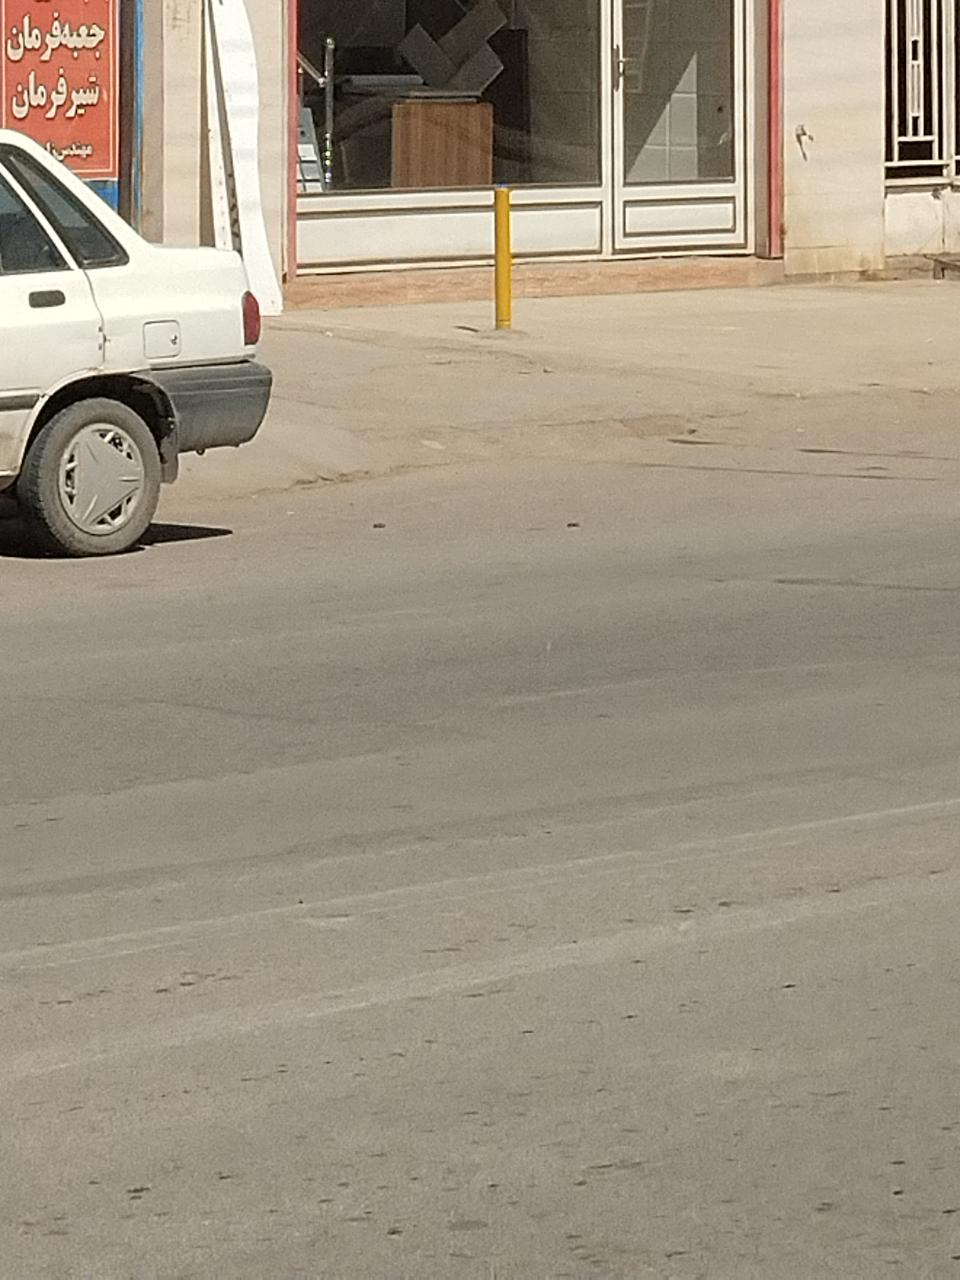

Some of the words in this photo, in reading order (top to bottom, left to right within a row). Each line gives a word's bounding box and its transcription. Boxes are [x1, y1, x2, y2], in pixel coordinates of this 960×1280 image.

[6, 11, 62, 62] فرمان
[61, 23, 105, 59] جعبه
[11, 68, 67, 119] فرمان
[65, 75, 100, 118] شیر
